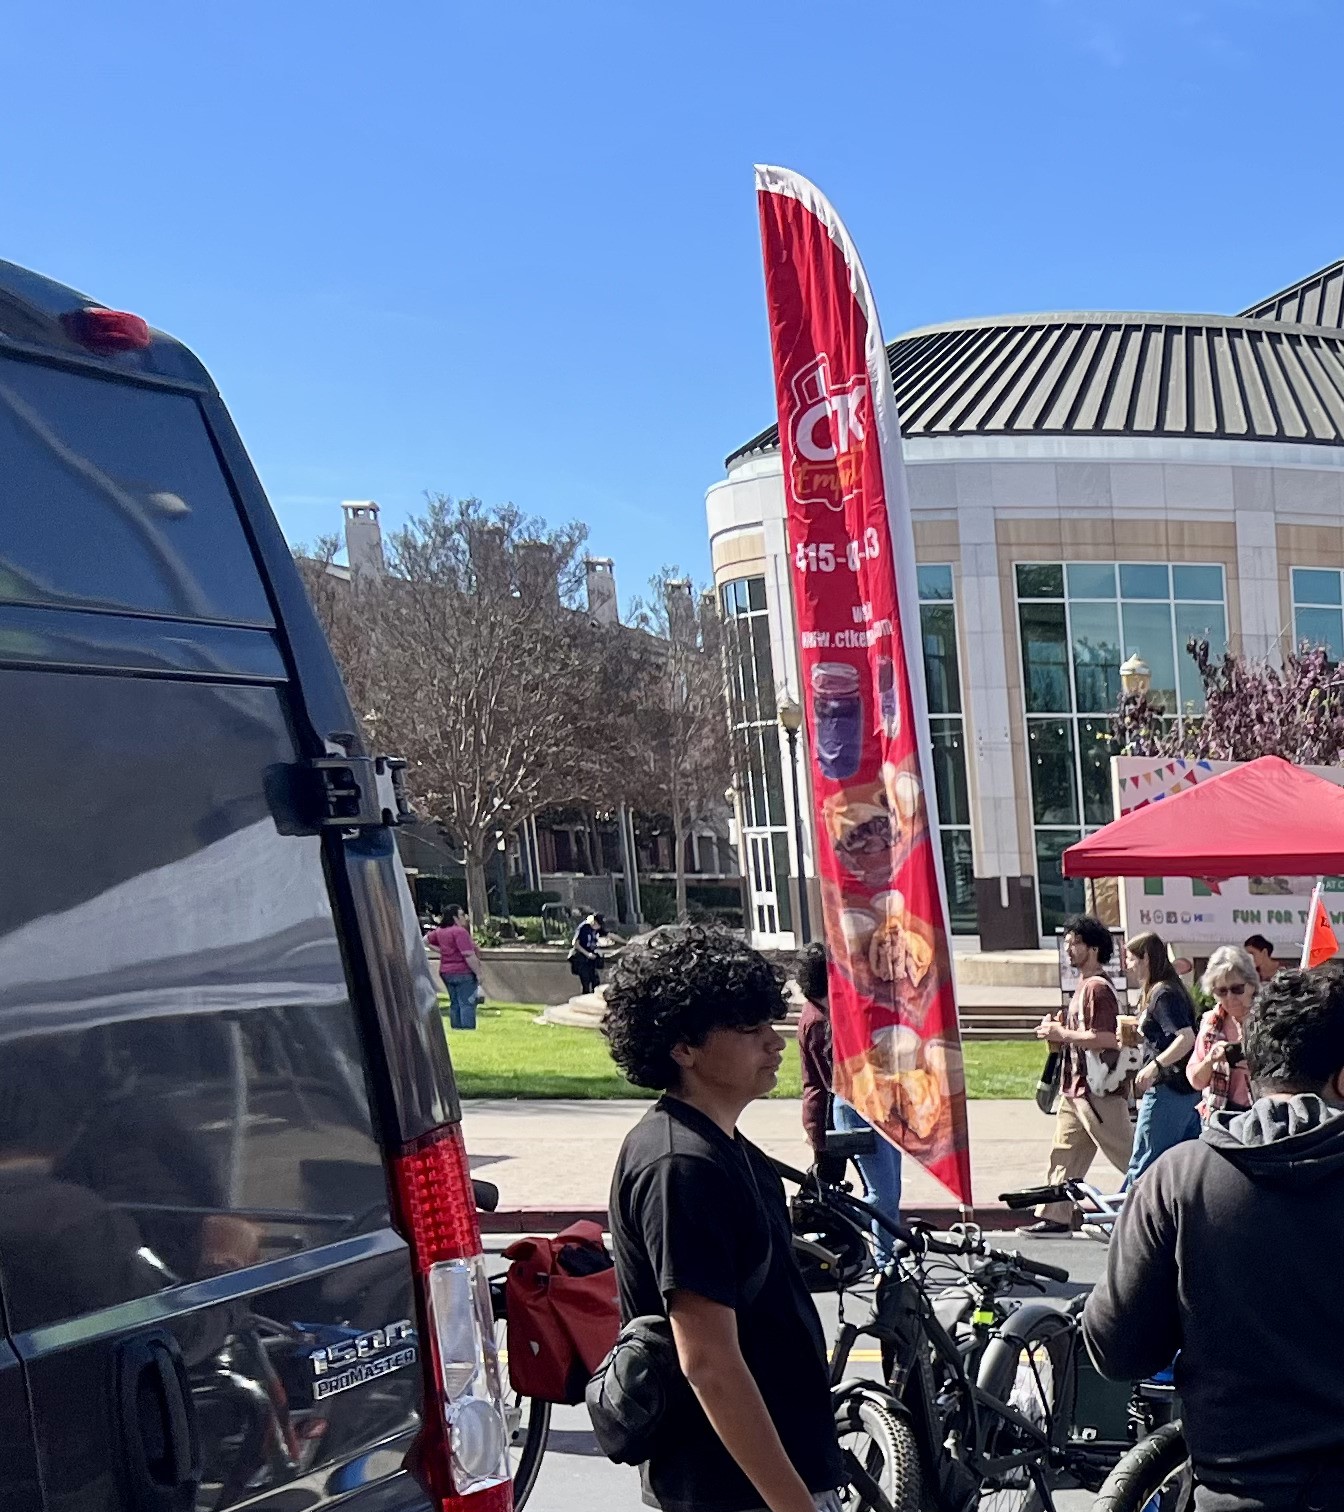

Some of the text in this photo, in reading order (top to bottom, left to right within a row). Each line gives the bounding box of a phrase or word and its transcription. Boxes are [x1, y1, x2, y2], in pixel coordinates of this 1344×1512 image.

[1325, 879, 1340, 890] AT
[1232, 909, 1261, 924] FUN
[1267, 909, 1293, 924] FOR
